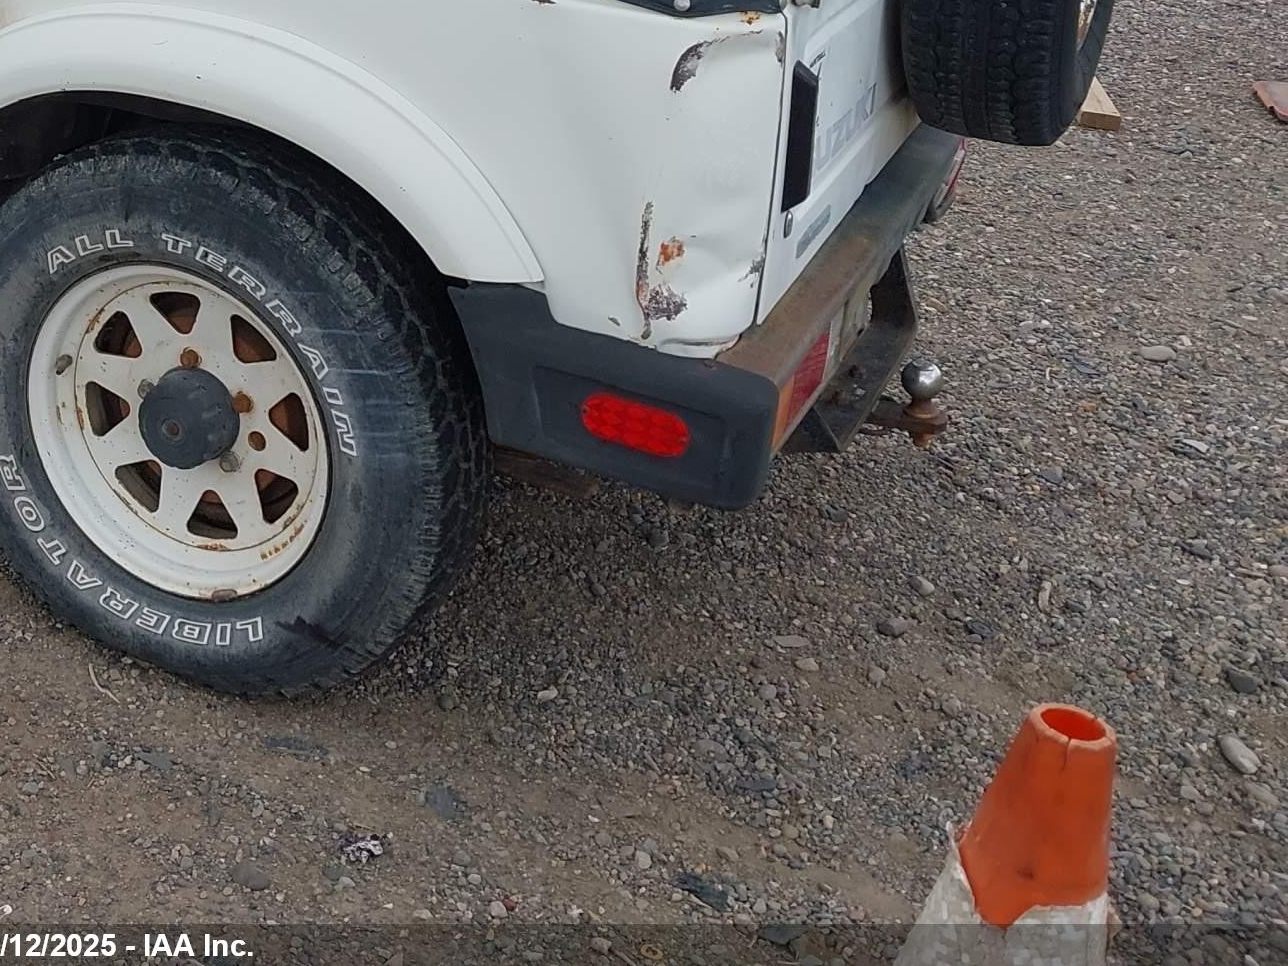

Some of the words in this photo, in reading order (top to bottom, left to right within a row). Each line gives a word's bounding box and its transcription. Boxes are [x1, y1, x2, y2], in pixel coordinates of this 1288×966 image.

[814, 82, 877, 172] UZUKI
[47, 229, 134, 275] ALL
[162, 233, 359, 458] TERRAIN
